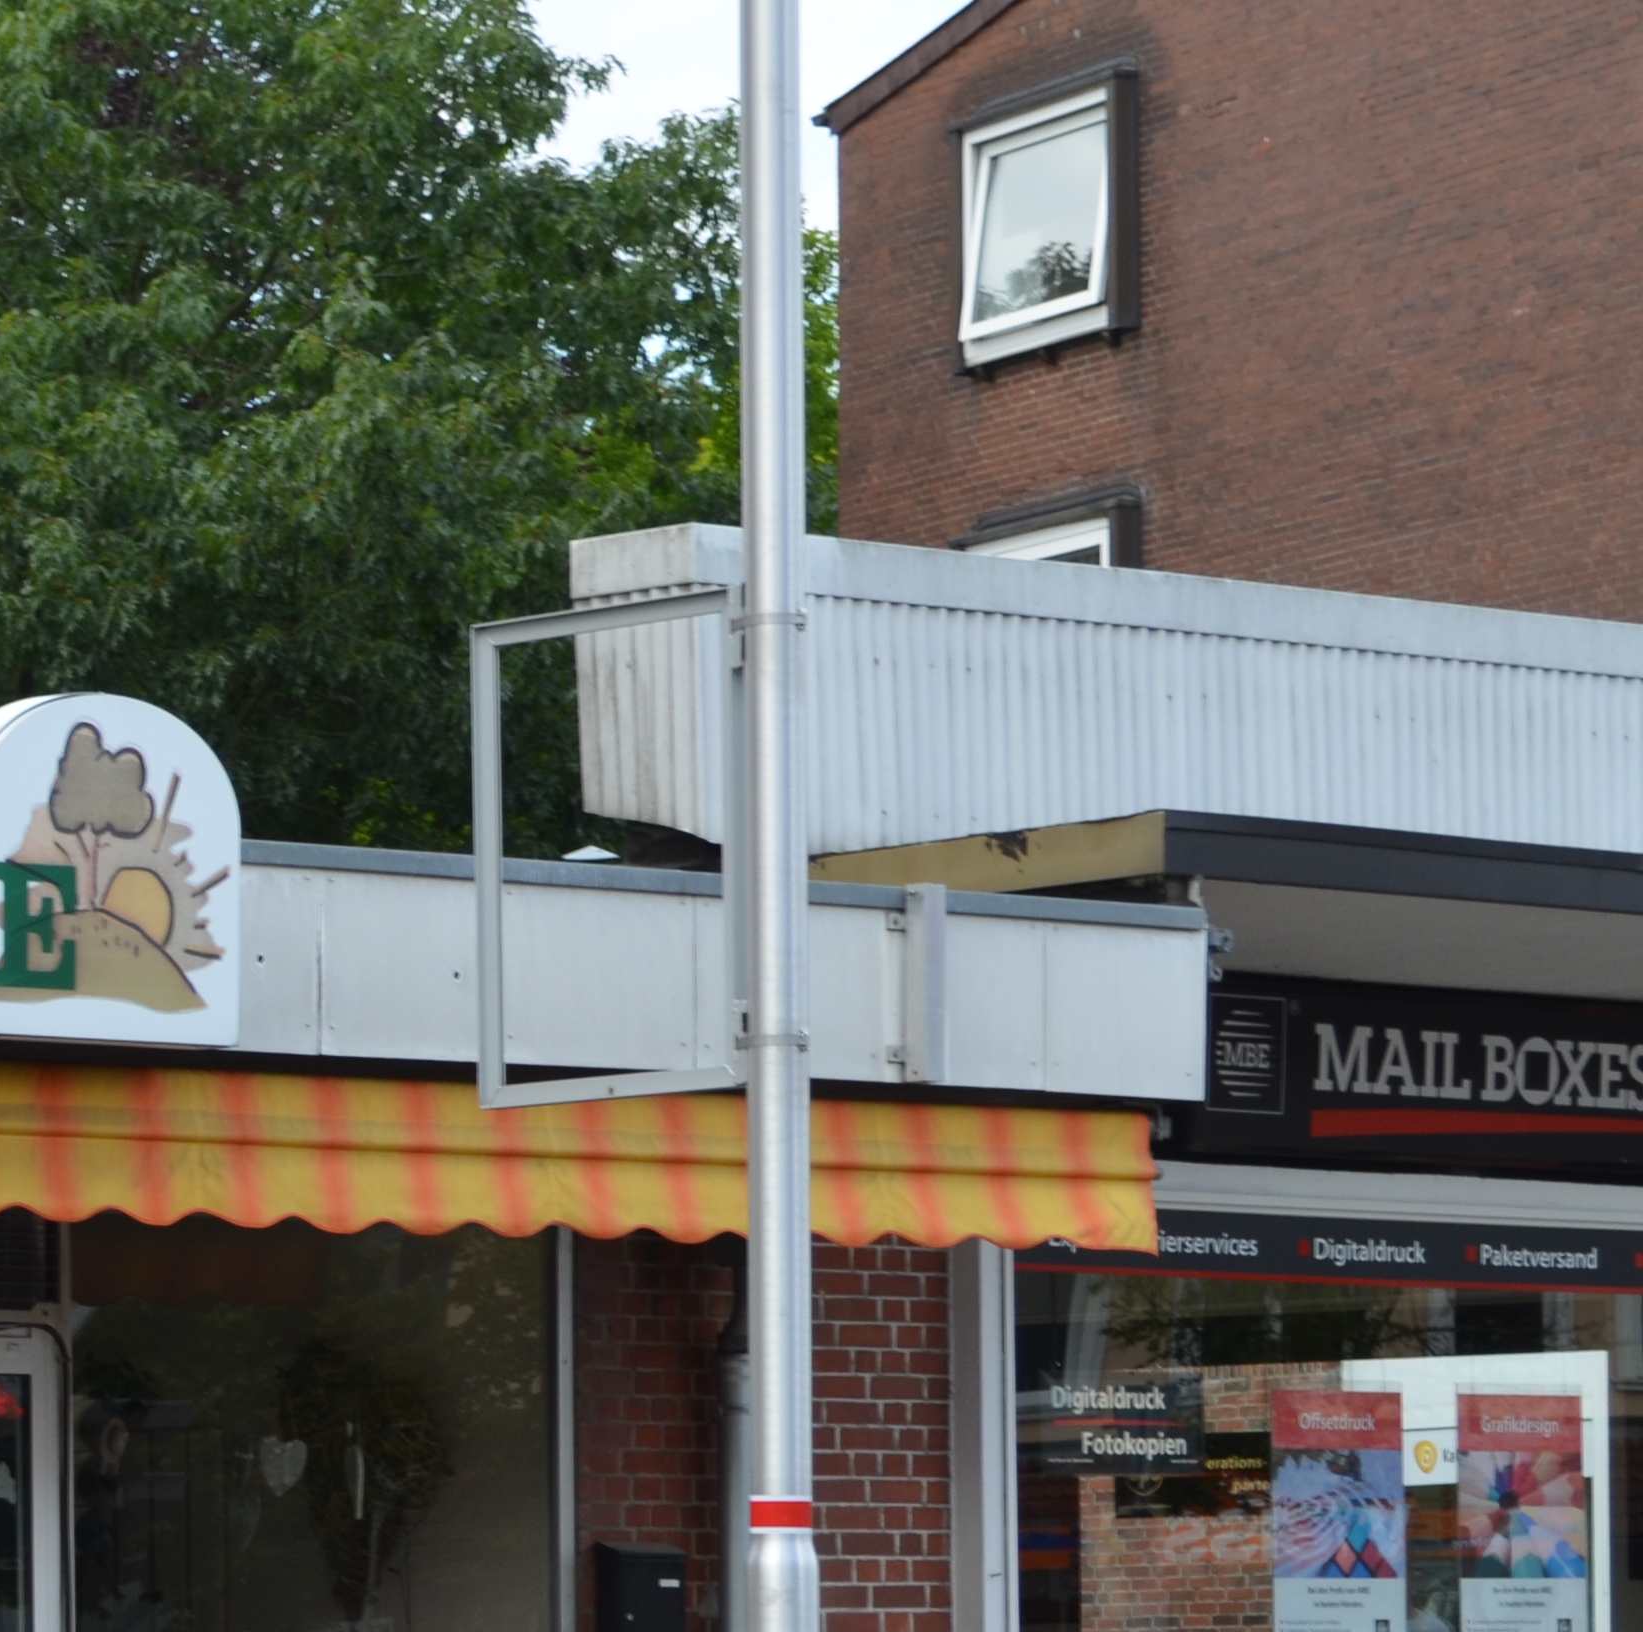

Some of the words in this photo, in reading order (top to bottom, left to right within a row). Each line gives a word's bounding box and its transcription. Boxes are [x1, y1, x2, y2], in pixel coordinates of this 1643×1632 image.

[1312, 1022, 1472, 1100] MAIL
[1313, 1237, 1426, 1267] Digitaldruck
[1479, 1243, 1598, 1270] Paketversand
[1049, 1384, 1167, 1415] Digitaldruck
[1297, 1411, 1376, 1432] Offsetdruck
[1481, 1415, 1560, 1438] Grafikdesign
[1080, 1430, 1188, 1461] Fotokopien
